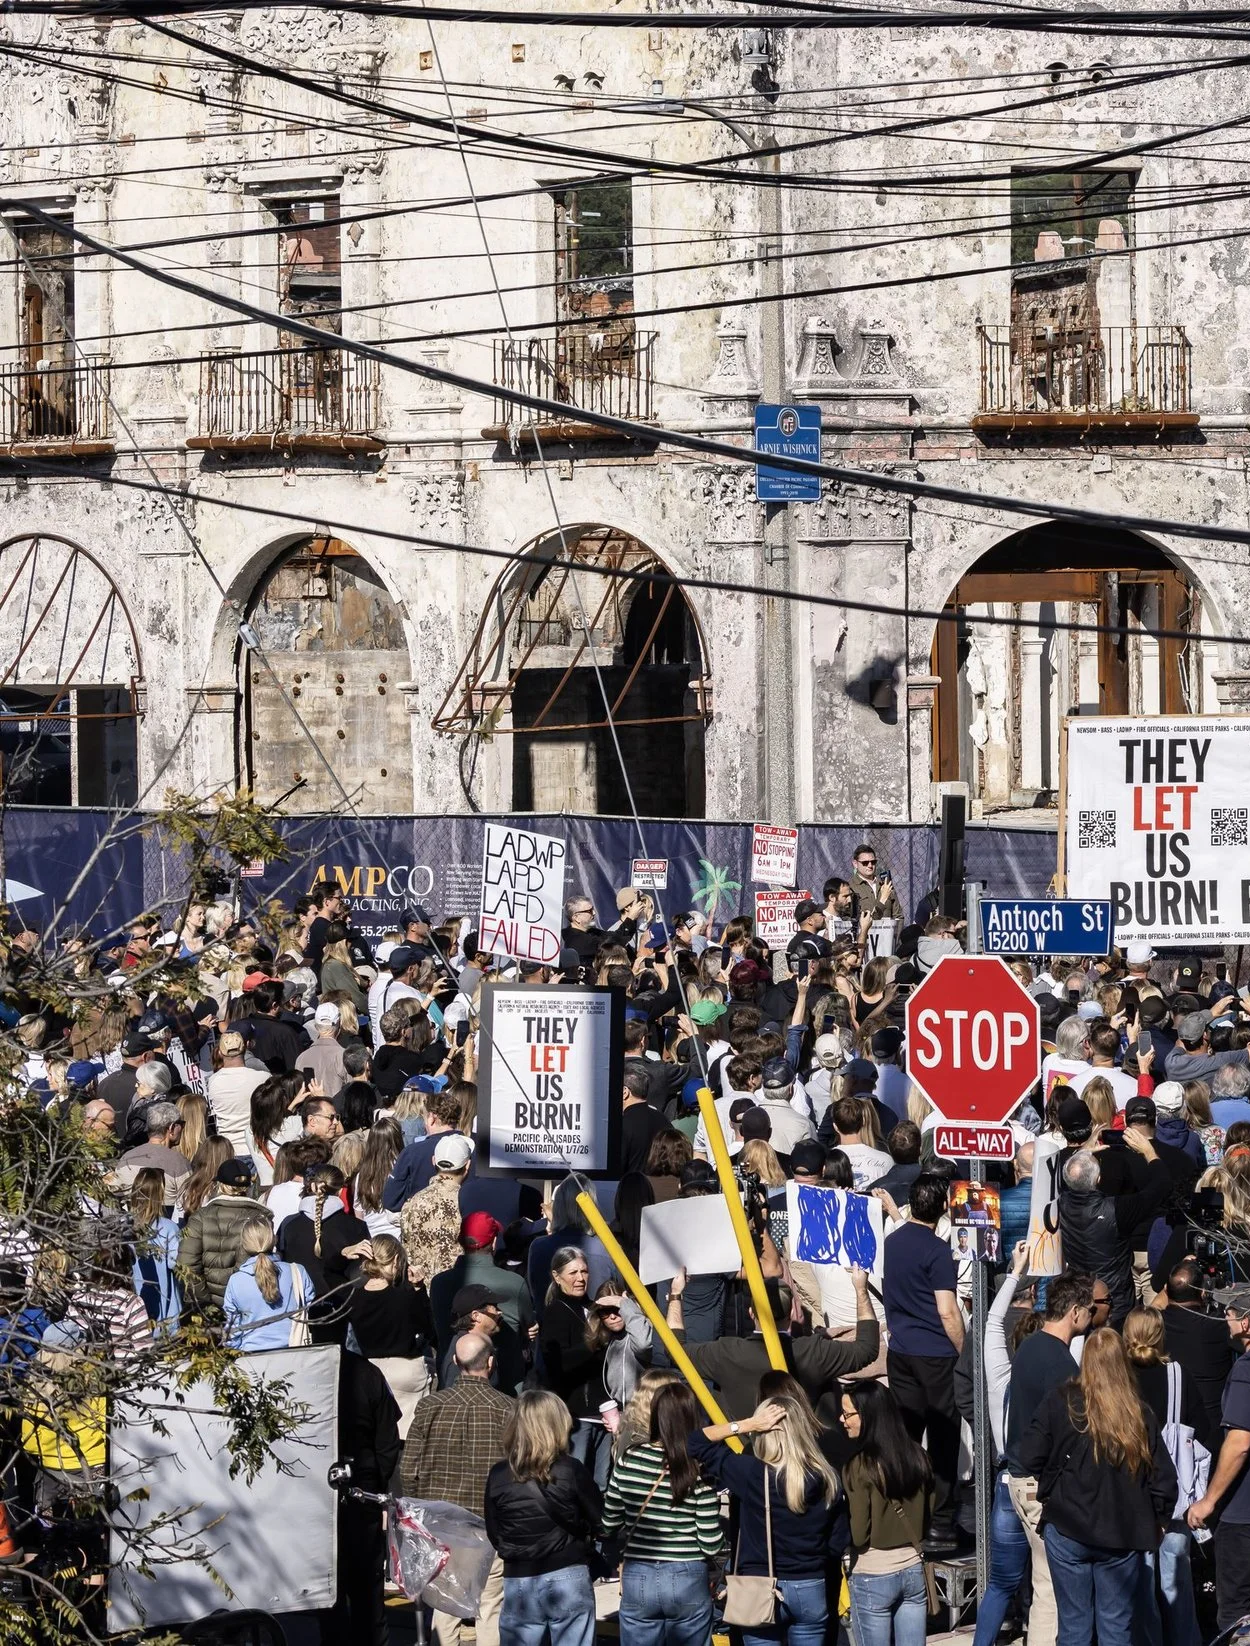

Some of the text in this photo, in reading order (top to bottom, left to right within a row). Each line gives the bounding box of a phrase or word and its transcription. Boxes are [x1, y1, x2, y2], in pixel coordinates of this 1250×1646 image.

[760, 444, 818, 454] ARNIE WISHNICK
[1119, 738, 1212, 784] THEY
[1134, 786, 1198, 830] LET
[486, 828, 565, 869] LADWP
[755, 841, 795, 858] NO STOPPING
[1146, 832, 1190, 878] US
[485, 857, 544, 892] LAPD
[758, 856, 790, 869] 6AM 1PM
[306, 864, 434, 897] AMPCO
[483, 886, 544, 923] LAFD
[760, 908, 776, 920] NO
[1110, 880, 1219, 926] BURN!
[762, 923, 778, 933] 7AM
[988, 904, 1104, 932] Antioch St
[480, 916, 560, 962] FAILED
[988, 932, 1045, 951] 15200 W
[523, 1017, 578, 1044] THEY
[916, 1008, 1030, 1071] STOP
[530, 1045, 570, 1072] LET
[186, 1064, 201, 1081] LET
[192, 1080, 203, 1095] US
[536, 1074, 563, 1101] US
[515, 1102, 581, 1130] BURN!
[504, 1143, 588, 1154] DEMONSTRATION 1/7/26
[513, 1133, 581, 1143] PACIFIC PALISADES
[938, 1132, 1009, 1152] ALL-WAY
